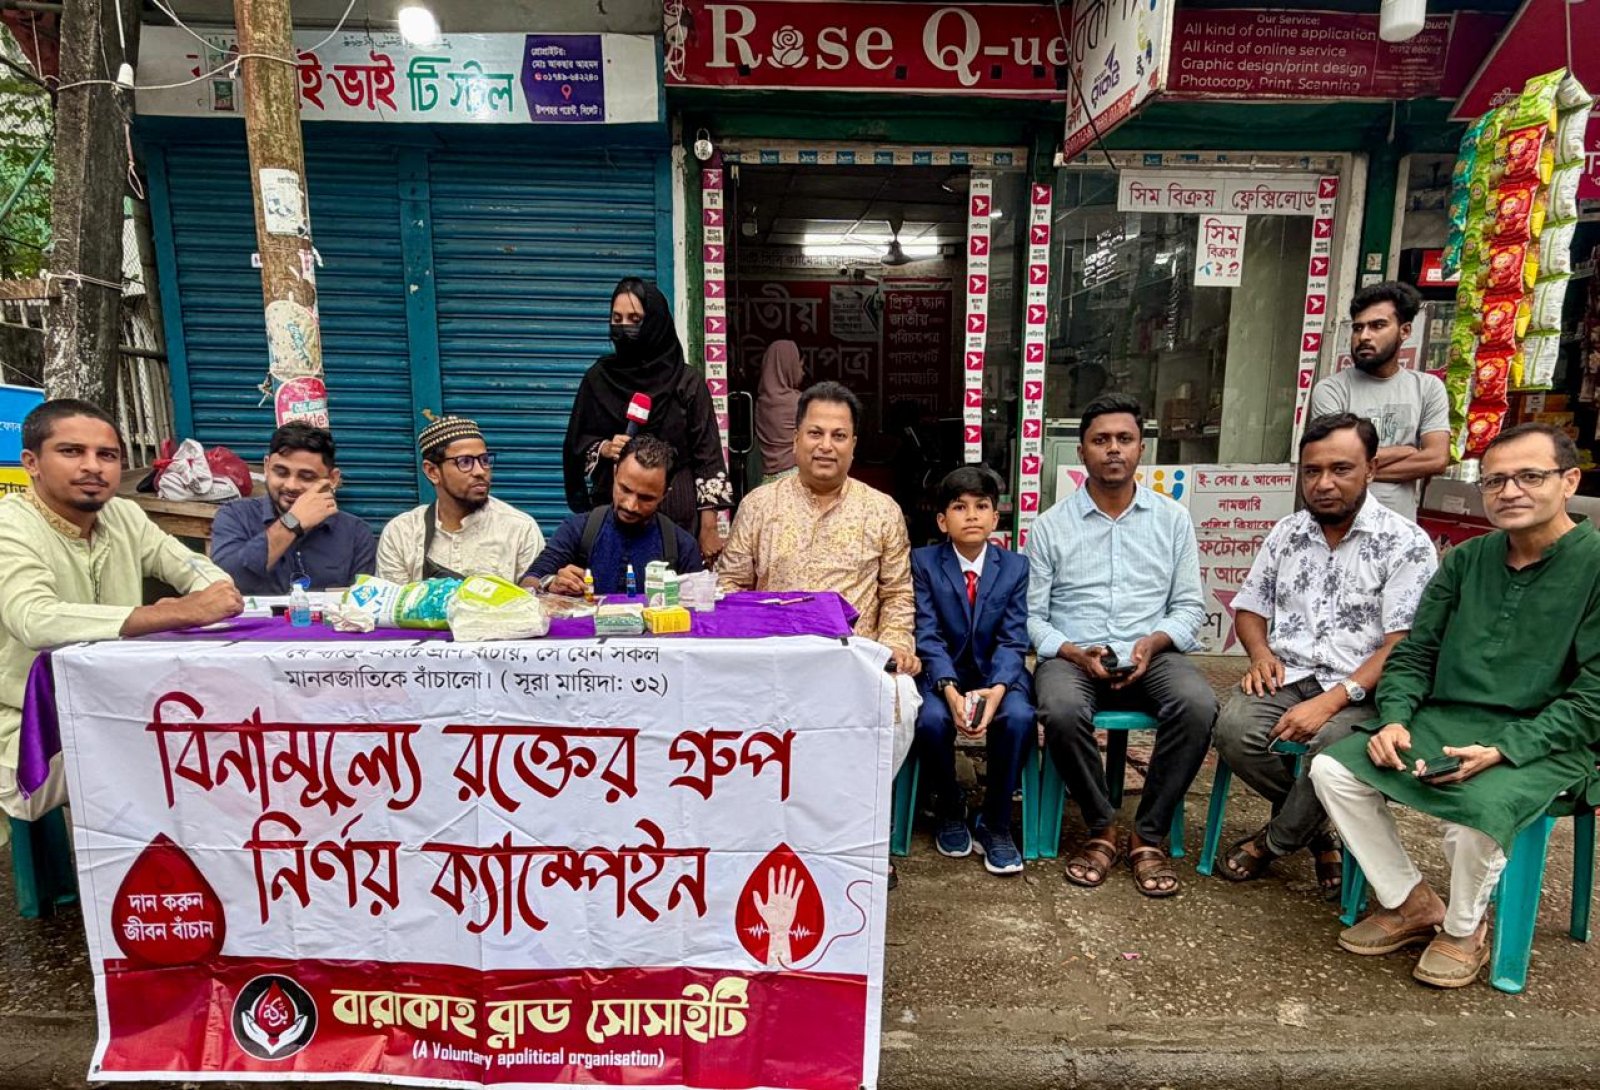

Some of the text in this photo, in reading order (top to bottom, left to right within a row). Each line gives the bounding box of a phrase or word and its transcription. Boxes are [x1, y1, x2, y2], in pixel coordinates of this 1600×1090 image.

[1257, 14, 1320, 25] Our Service:
[1424, 20, 1449, 30] ouch
[1184, 23, 1377, 41] All kind of online application
[1183, 40, 1347, 58] All kind of online service
[1181, 57, 1234, 72] Graphic
[1237, 59, 1319, 75] design/print
[1322, 62, 1367, 77] design
[326, 50, 398, 111] ভাই
[406, 56, 451, 112] টি
[1298, 78, 1360, 92] Scanning
[1129, 180, 1161, 206] সিম
[1167, 181, 1216, 208] বিক্রয়
[1203, 218, 1243, 244] সিম
[1207, 244, 1238, 259] বিক্রয়
[1215, 475, 1237, 487] সেবা
[1240, 476, 1250, 487] &
[1253, 474, 1292, 487] আবেদন
[1218, 495, 1261, 513] নামজারি
[611, 646, 660, 664] সকল
[285, 664, 407, 689] মানবজাতিকে
[513, 672, 549, 698] সূরা
[145, 690, 798, 816] বিনামূল্যে রক্তের গ্রুপ
[243, 810, 711, 936] নির্ণয় ক্যাম্পেইন
[128, 892, 204, 913] দান করুন
[122, 915, 215, 941] জীবন বাঁচান
[330, 976, 750, 1050] বারাকাহ ব্লাড সোসাইটি
[412, 1039, 665, 1070] (A Voluntary apolitical organisation)
